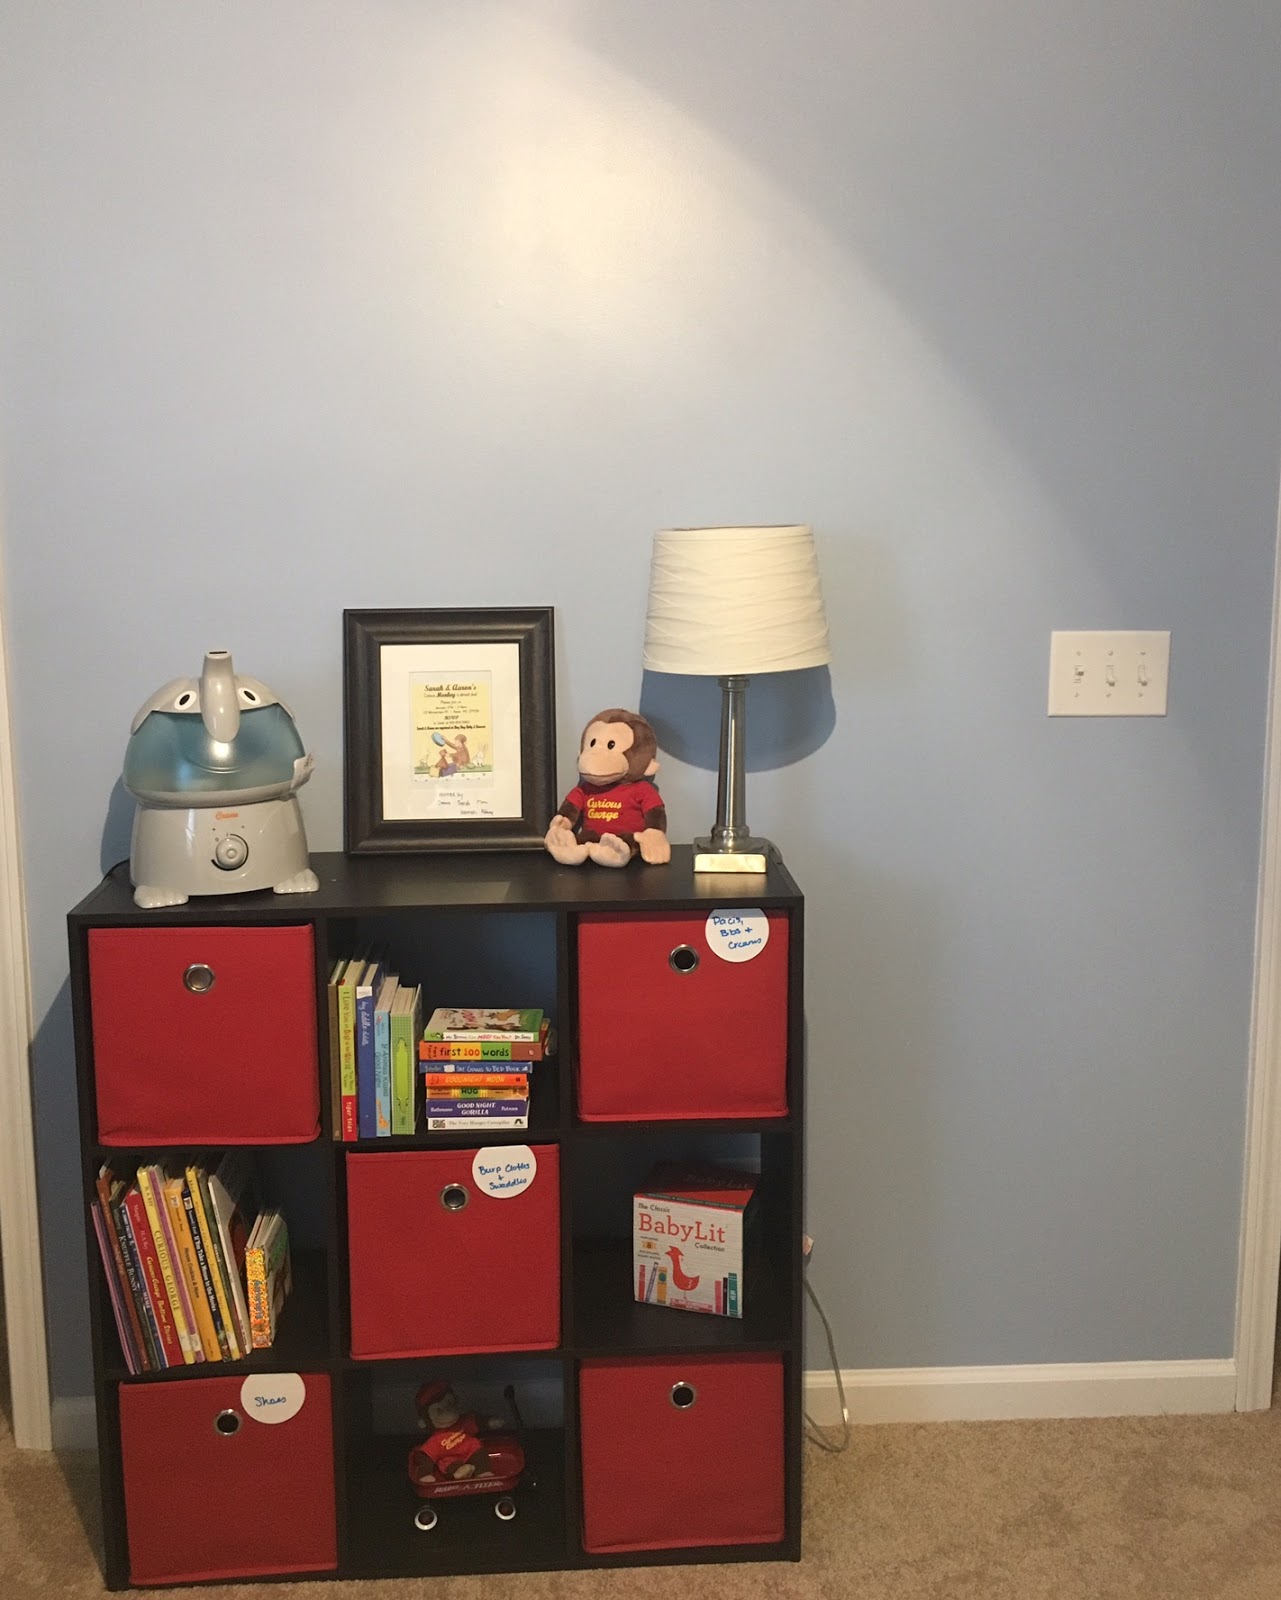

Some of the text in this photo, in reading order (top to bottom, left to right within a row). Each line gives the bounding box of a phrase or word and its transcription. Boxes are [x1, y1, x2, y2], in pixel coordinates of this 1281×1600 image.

[587, 797, 622, 809] Curious
[587, 809, 619, 822] George
[342, 995, 351, 1010] Love
[343, 1028, 351, 1040] Big
[440, 1047, 461, 1057] first
[464, 1048, 480, 1057] 100
[482, 1048, 509, 1057] words
[343, 1052, 352, 1070] World
[478, 1165, 502, 1175] Burp
[489, 1178, 527, 1190] Swaddles
[650, 1204, 670, 1213] Classic
[638, 1213, 726, 1243] BabyLit
[194, 1239, 202, 1250] You
[694, 1242, 726, 1252] Collection
[196, 1248, 205, 1262] Take
[117, 1233, 133, 1267] KNUFFLE
[126, 1266, 139, 1291] BUNNY
[145, 1255, 158, 1279] Curious
[152, 1229, 181, 1311] CURIOUS GEORGE
[200, 1264, 210, 1281] Mouse
[150, 1277, 163, 1298] George
[207, 1294, 218, 1312] Movies
[254, 1396, 287, 1407] Shoes
